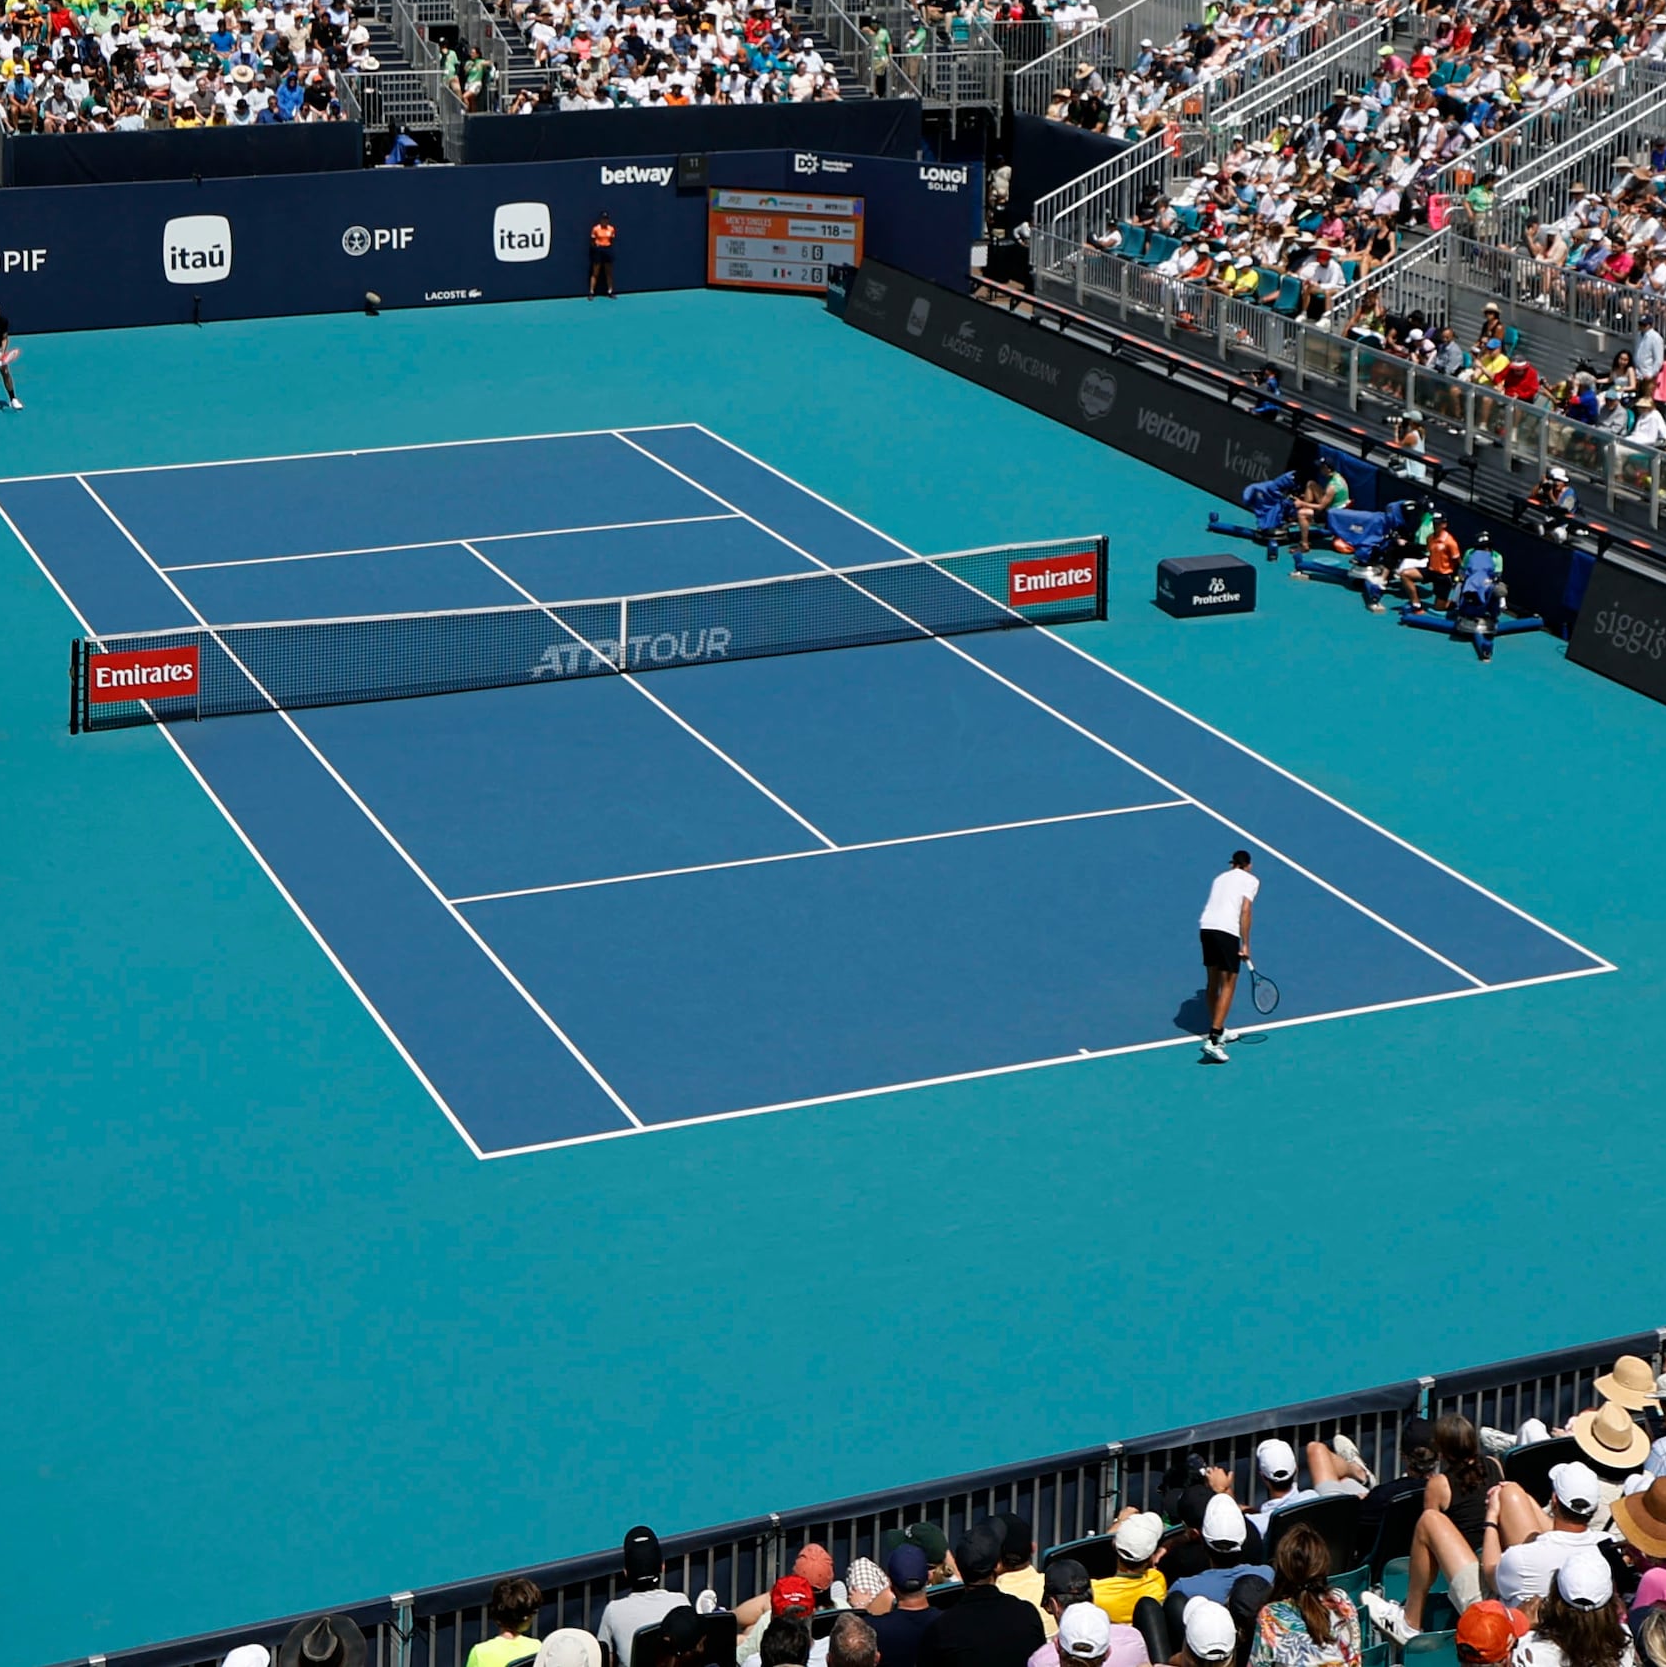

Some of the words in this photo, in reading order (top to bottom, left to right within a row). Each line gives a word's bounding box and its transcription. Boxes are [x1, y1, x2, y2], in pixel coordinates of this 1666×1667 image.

[601, 166, 673, 186] betway
[928, 182, 958, 193] SOLAR
[375, 228, 414, 250] PIF
[500, 228, 545, 250] itaú
[821, 225, 840, 236] 118
[3, 249, 47, 272] PIF
[170, 244, 225, 270] itaú
[814, 247, 822, 259] 6
[814, 269, 822, 282] 6
[425, 290, 467, 301] LACOSTE
[942, 334, 984, 363] LACOSTE
[1137, 407, 1201, 454] verizon
[1225, 437, 1269, 481] Venus
[1013, 566, 1092, 593] Emirates
[1192, 592, 1240, 606] Protective
[1594, 601, 1666, 660] siggi's
[531, 637, 619, 678] ATP
[627, 626, 732, 664] TOUR
[96, 663, 193, 689] Emirates
